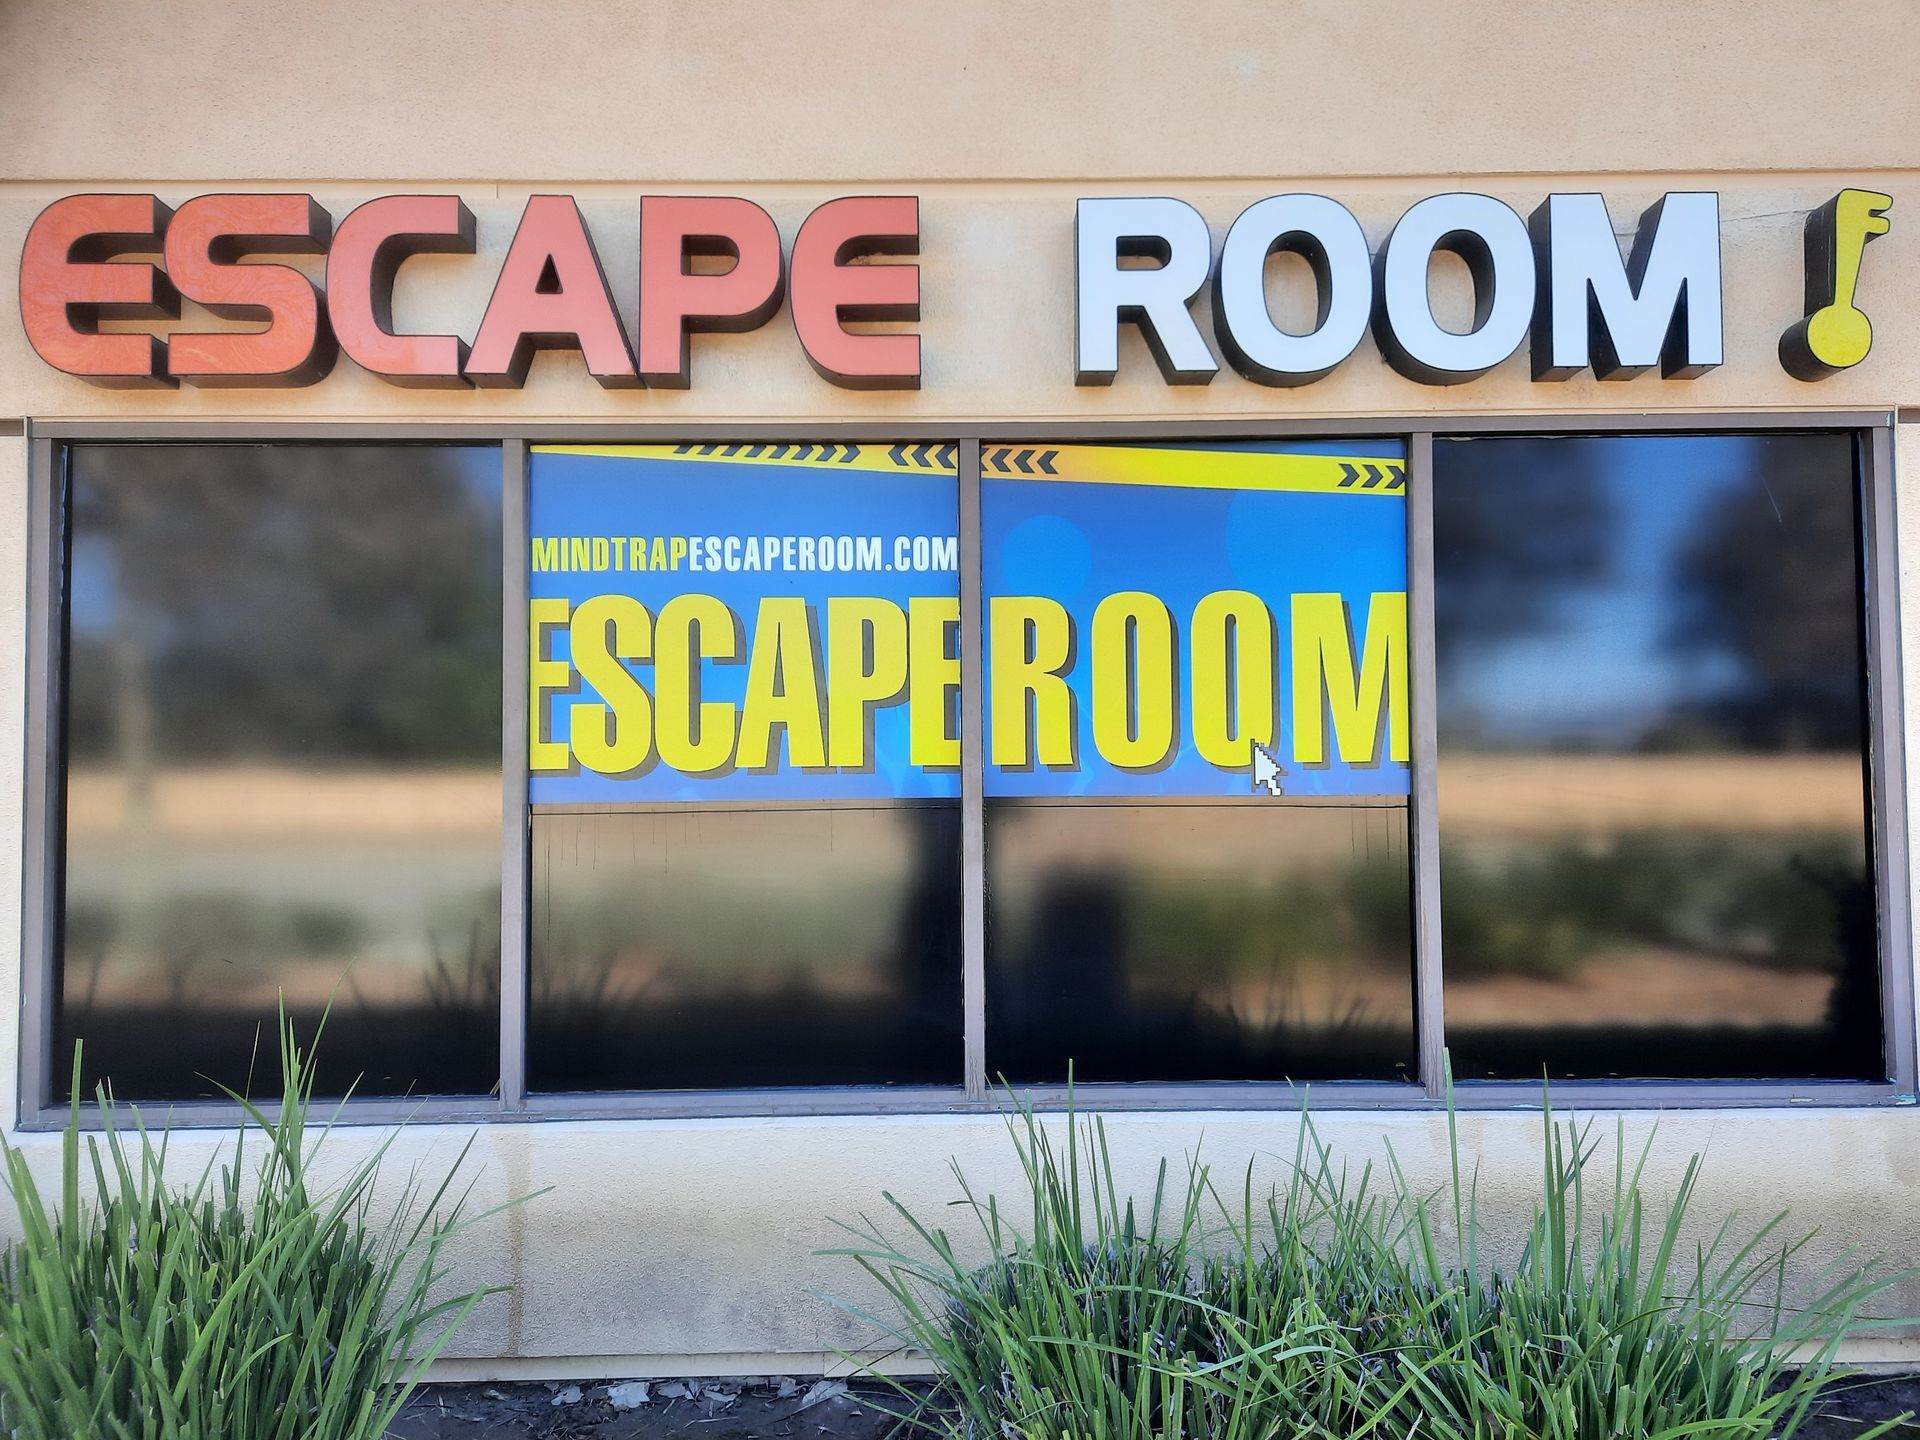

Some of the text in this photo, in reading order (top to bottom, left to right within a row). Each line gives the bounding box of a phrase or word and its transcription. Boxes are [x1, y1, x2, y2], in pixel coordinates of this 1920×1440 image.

[19, 191, 1724, 380] ESCAPE ROOM
[531, 535, 958, 573] MINDTRAPESCAPEROOM.COM
